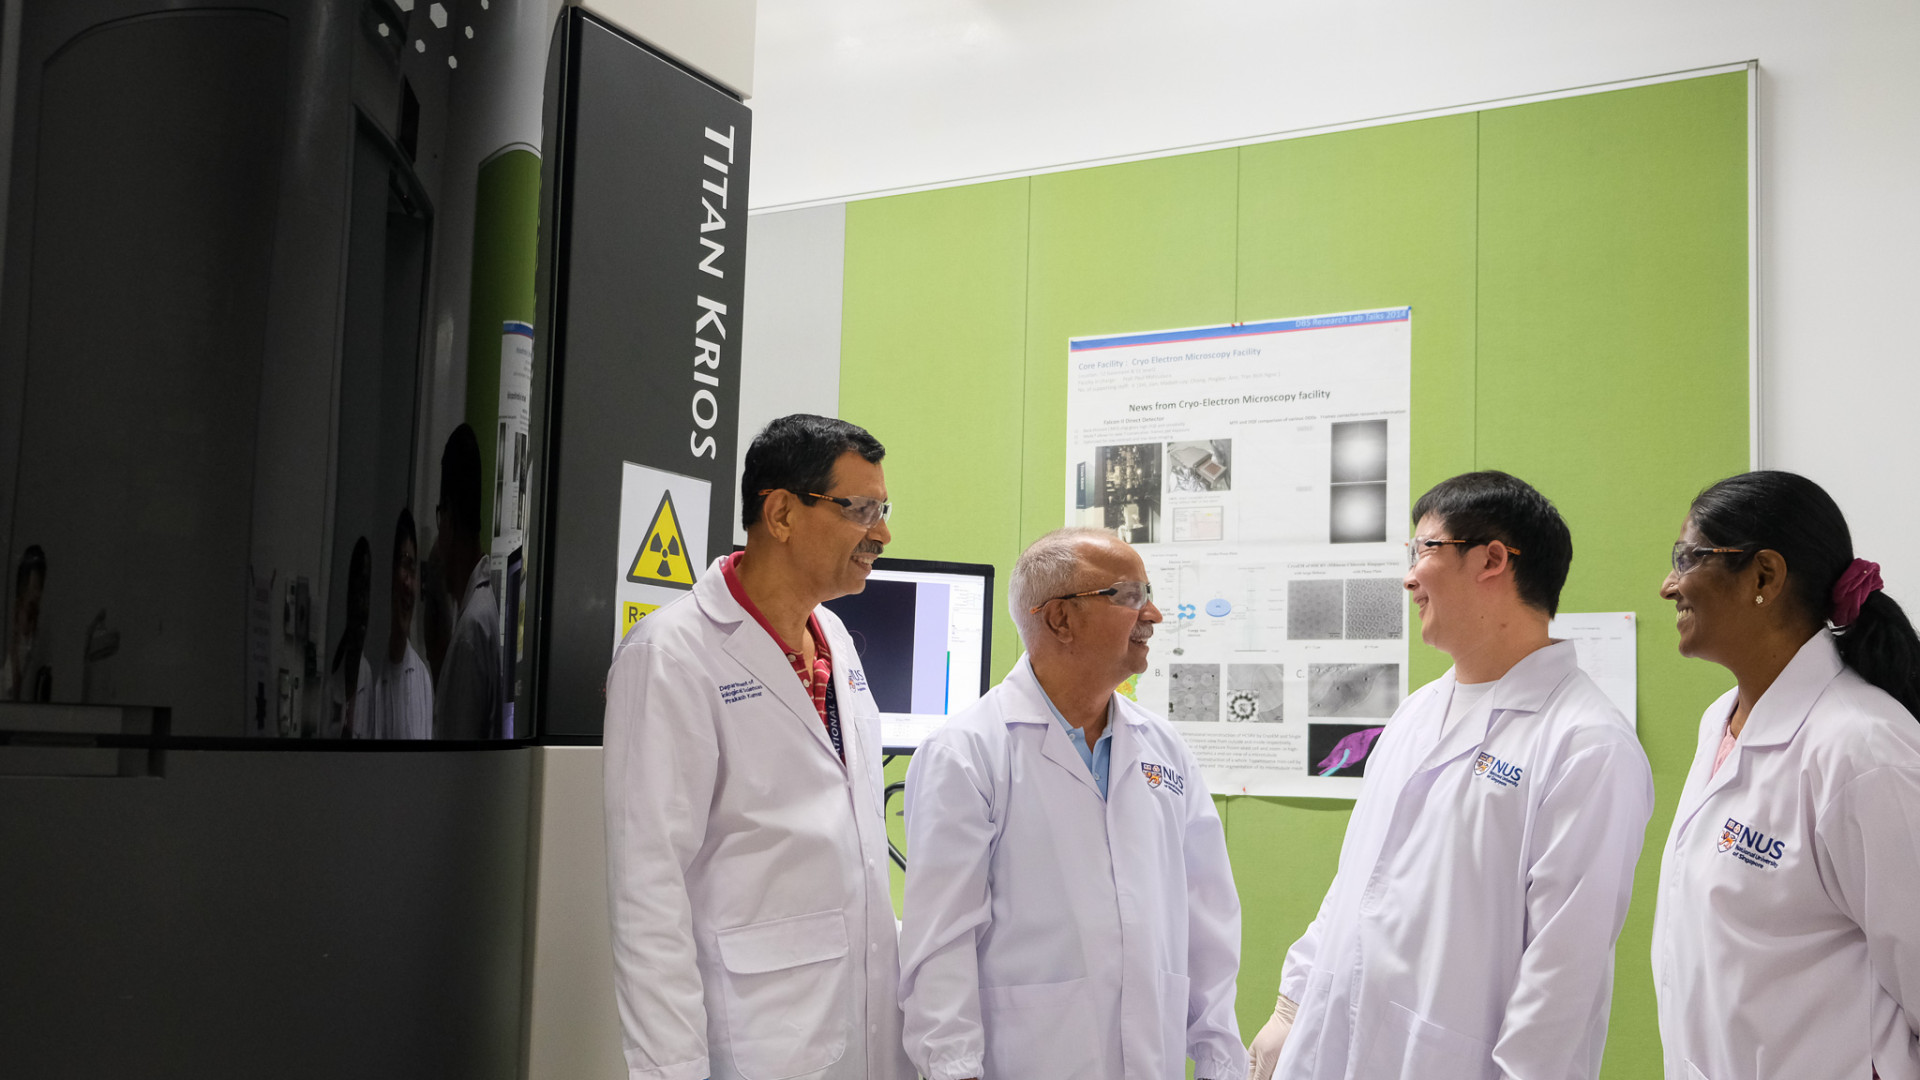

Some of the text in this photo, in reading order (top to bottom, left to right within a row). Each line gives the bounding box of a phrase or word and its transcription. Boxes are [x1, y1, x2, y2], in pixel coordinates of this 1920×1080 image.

[690, 126, 734, 460] TITAN KRIOS
[1312, 315, 1347, 326] Research
[1349, 313, 1364, 323] Lab
[1366, 311, 1384, 321] Talks
[1386, 310, 1406, 319] 2014
[1078, 362, 1095, 371] Core
[1097, 360, 1123, 369] Facility
[1131, 357, 1149, 366] Cryo
[1151, 355, 1183, 364] Electron
[1185, 351, 1231, 361] Microscopy
[1233, 347, 1261, 357] Facility
[1129, 389, 1331, 412] News from Cryo-Electron Microscopy facility
[1142, 415, 1165, 423] Detector
[1162, 766, 1184, 790] NUS
[1491, 759, 1523, 781] NUS
[1739, 827, 1785, 860] NUS
